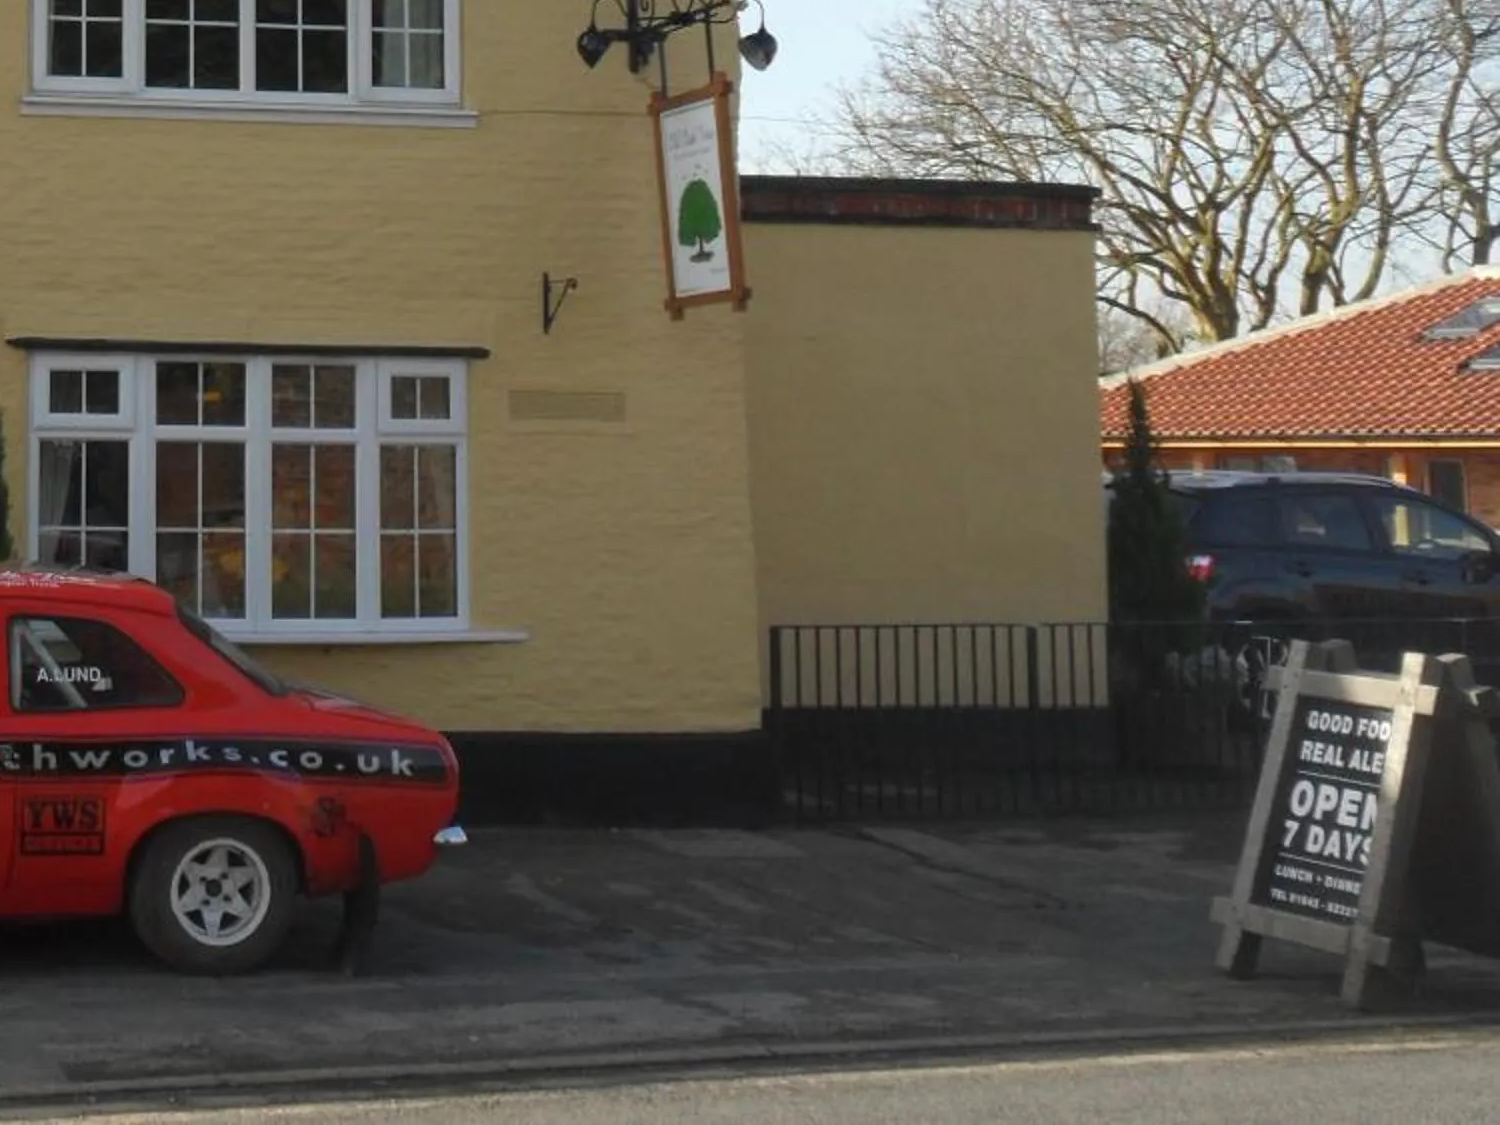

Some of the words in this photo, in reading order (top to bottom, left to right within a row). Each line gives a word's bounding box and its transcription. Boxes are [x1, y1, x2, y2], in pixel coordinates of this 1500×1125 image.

[1307, 710, 1353, 735] GOOD
[1357, 718, 1392, 742] FOO
[1300, 740, 1345, 767] REAL
[1289, 779, 1379, 831] OPEN
[1282, 820, 1300, 848] 7
[1304, 824, 1373, 866] DAYS
